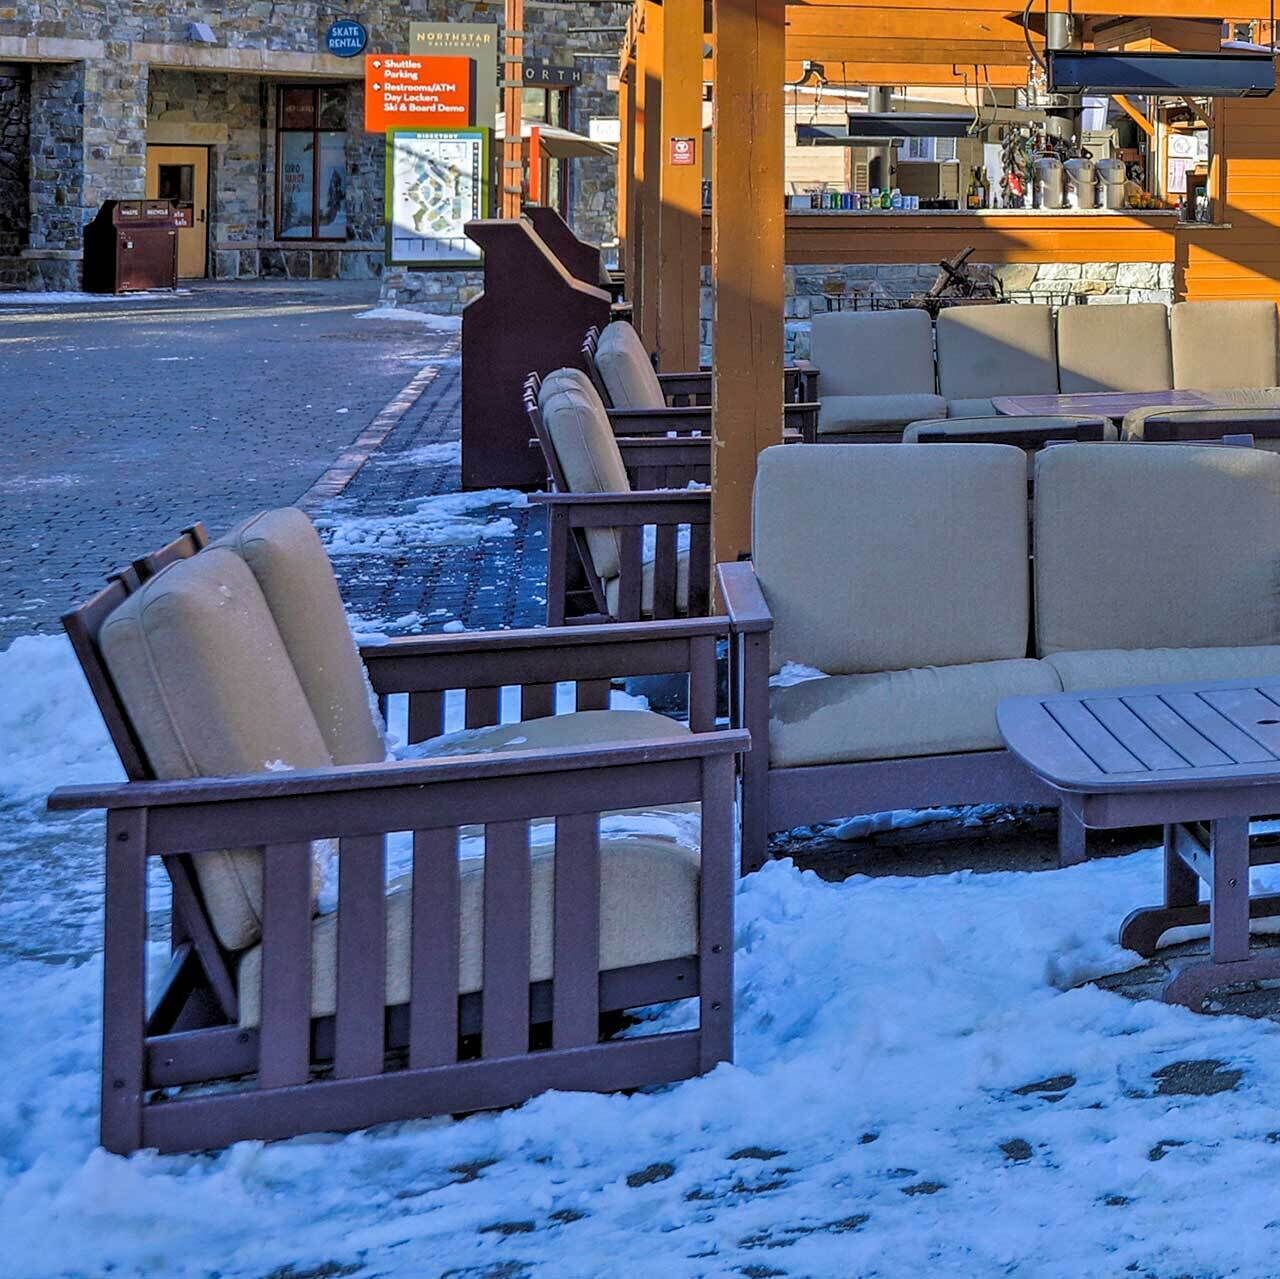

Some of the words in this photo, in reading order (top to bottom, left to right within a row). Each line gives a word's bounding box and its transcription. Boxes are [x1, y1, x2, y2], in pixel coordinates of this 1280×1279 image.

[331, 26, 359, 37] SKATE
[328, 37, 362, 48] RENTAL
[416, 32, 491, 44] NORTHSTAR
[384, 59, 422, 69] Shuttles
[384, 70, 419, 81] Parking
[525, 67, 581, 81] ORTH
[384, 83, 456, 93] Restrooms/ATM
[384, 93, 402, 103] Day
[403, 93, 439, 102] Lockers
[383, 103, 398, 112] Ski
[399, 104, 407, 112] &
[409, 103, 436, 113] Board
[437, 104, 465, 113] Demo
